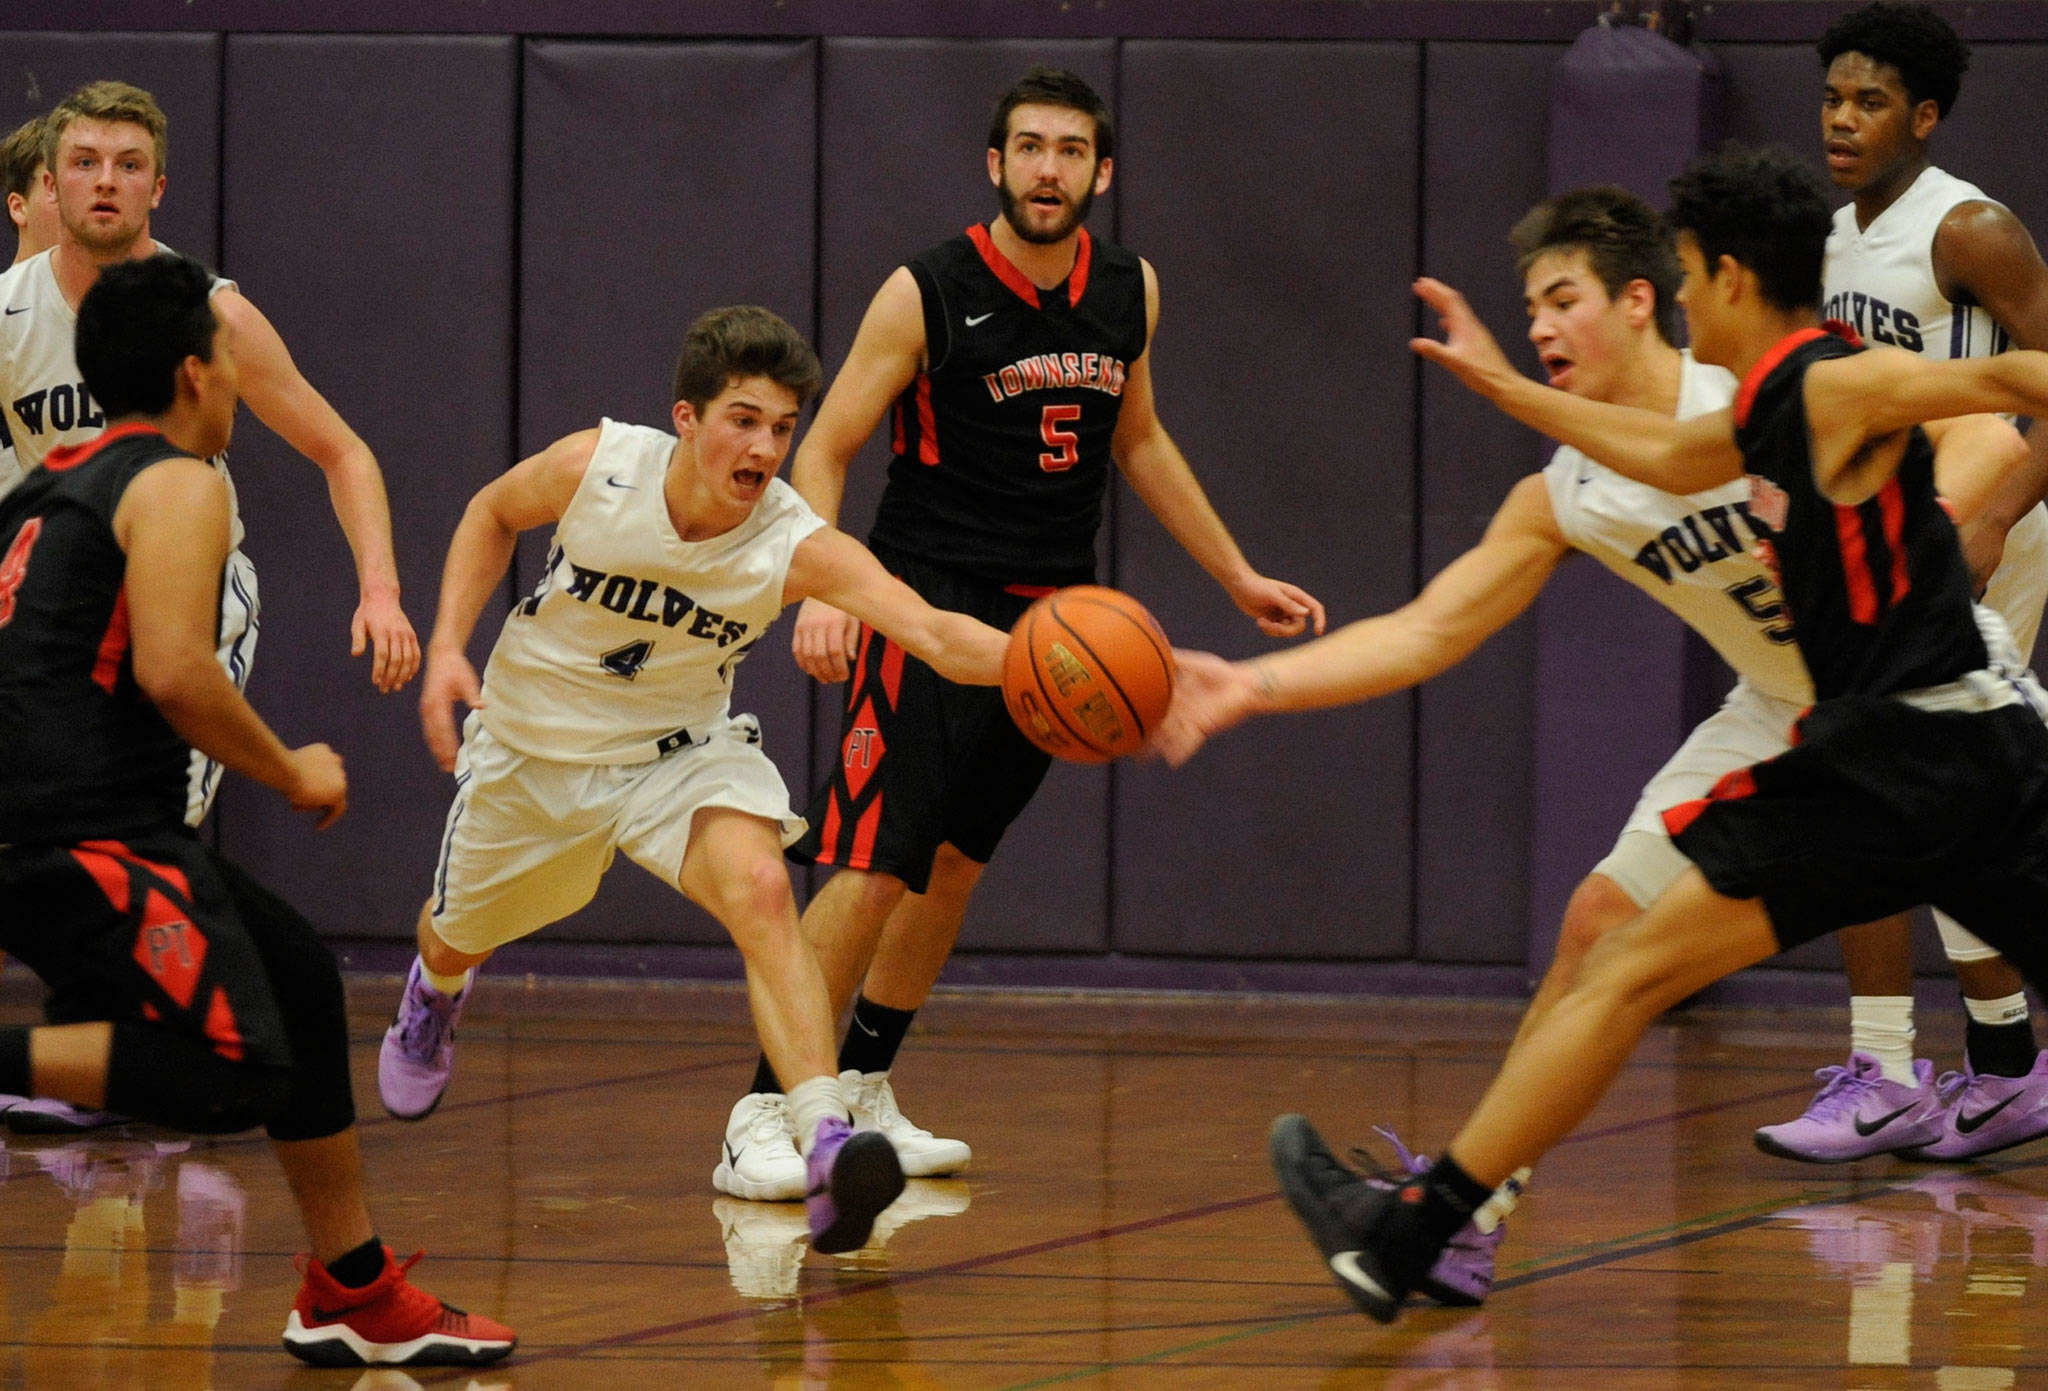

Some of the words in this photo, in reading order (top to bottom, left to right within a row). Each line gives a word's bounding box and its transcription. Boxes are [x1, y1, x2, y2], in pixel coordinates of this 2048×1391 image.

[1823, 291, 1924, 353] OLVES
[982, 352, 1125, 403] TOWNSEND
[1039, 404, 1081, 472] 5
[566, 565, 748, 648] WOLVES
[1726, 574, 1797, 645] 5
[600, 639, 655, 681] 4
[845, 727, 876, 768] PT
[145, 919, 194, 976] PT
